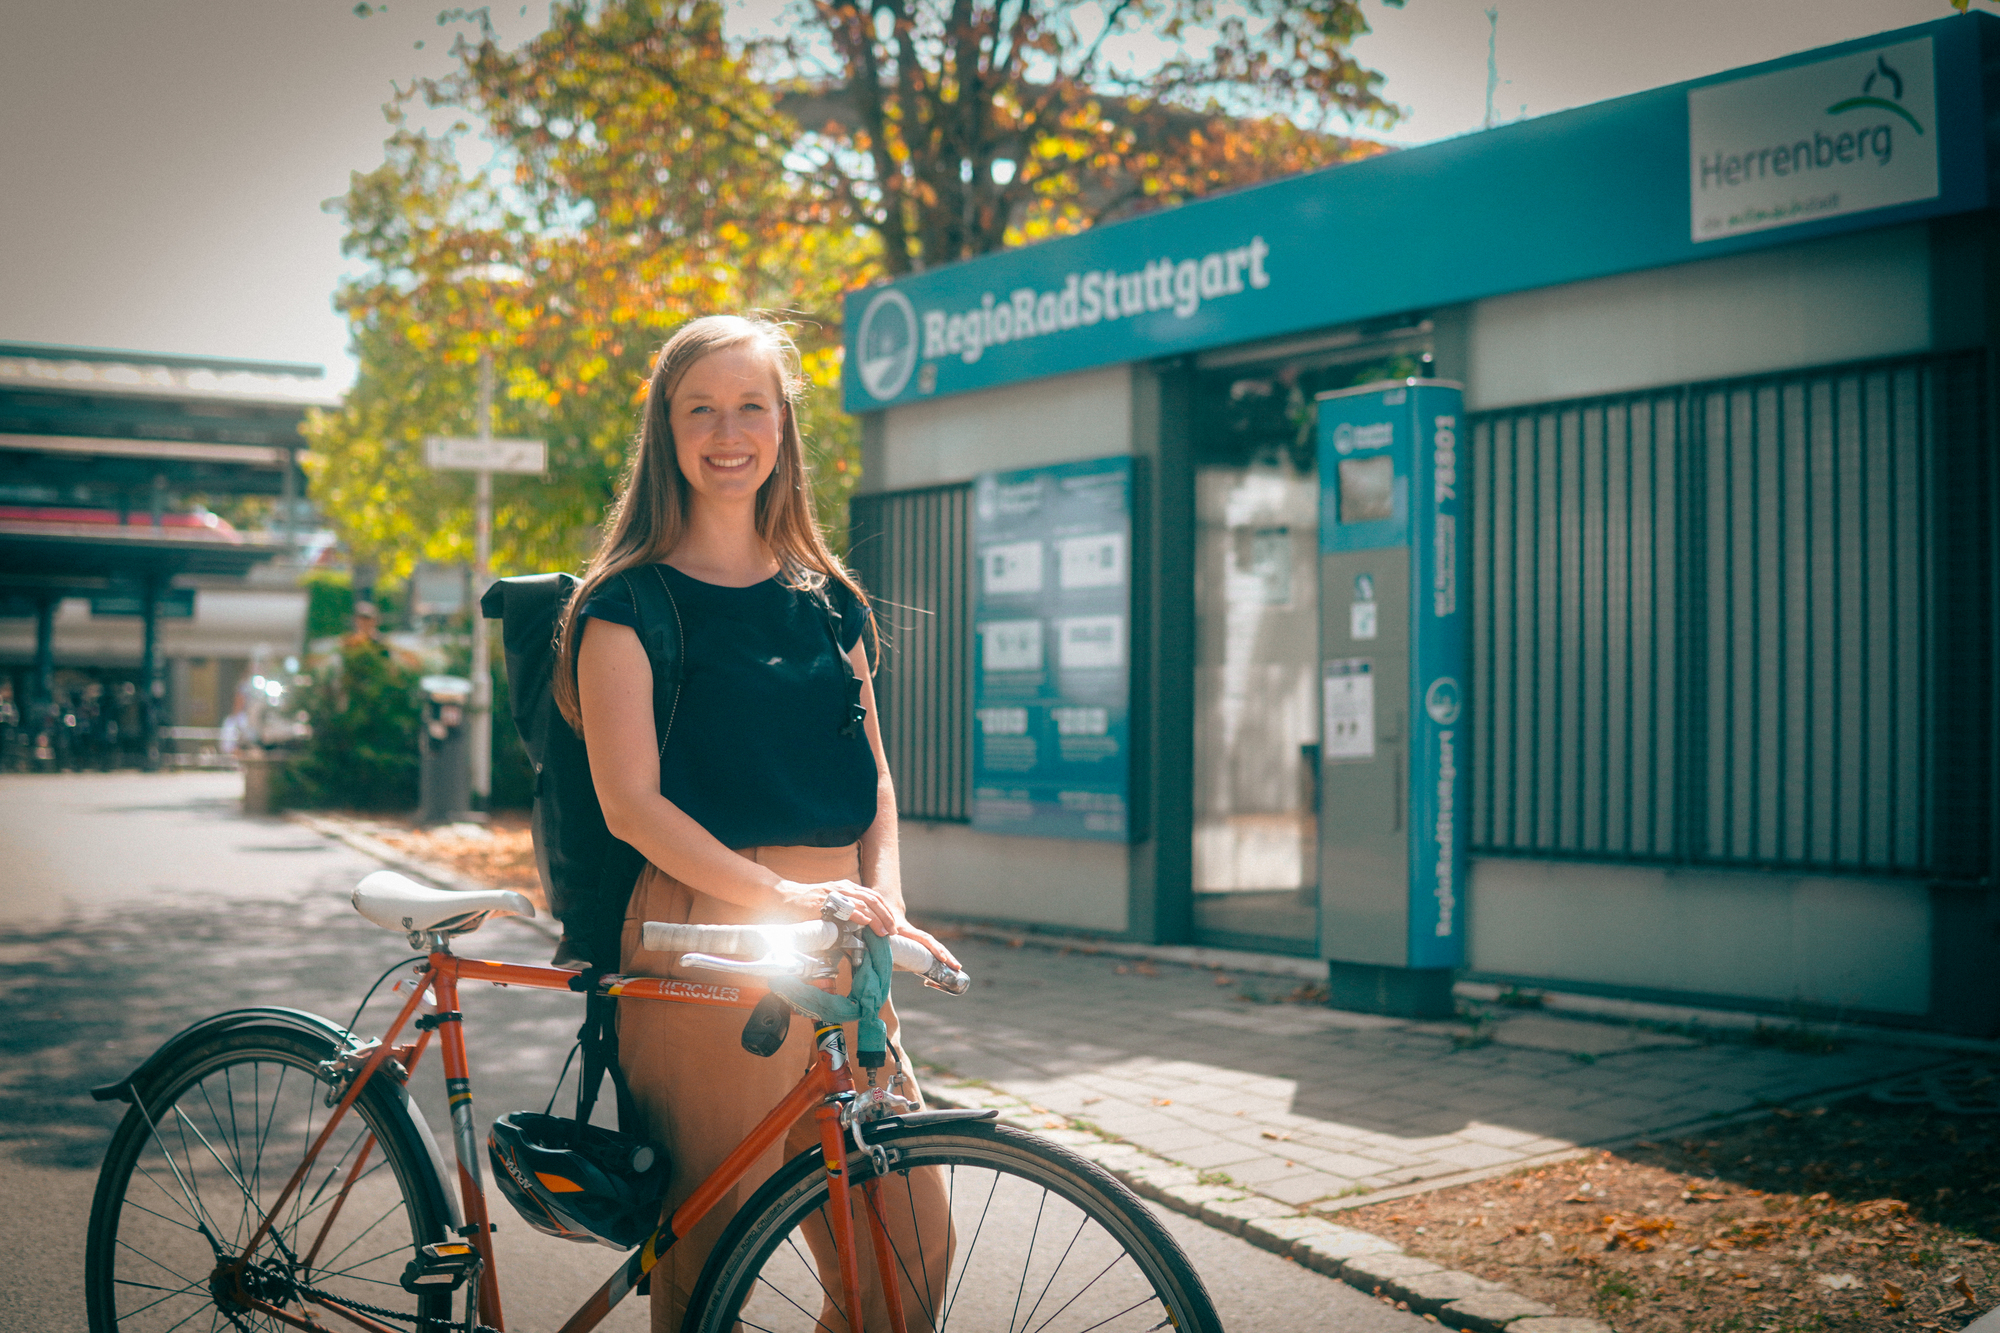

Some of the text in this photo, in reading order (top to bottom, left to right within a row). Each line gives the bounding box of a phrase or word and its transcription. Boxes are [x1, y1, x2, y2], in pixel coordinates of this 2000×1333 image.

[1699, 124, 1893, 190] Herrenberg
[921, 236, 1270, 363] RegioRadStuttgart
[658, 980, 740, 1002] HERCULES
